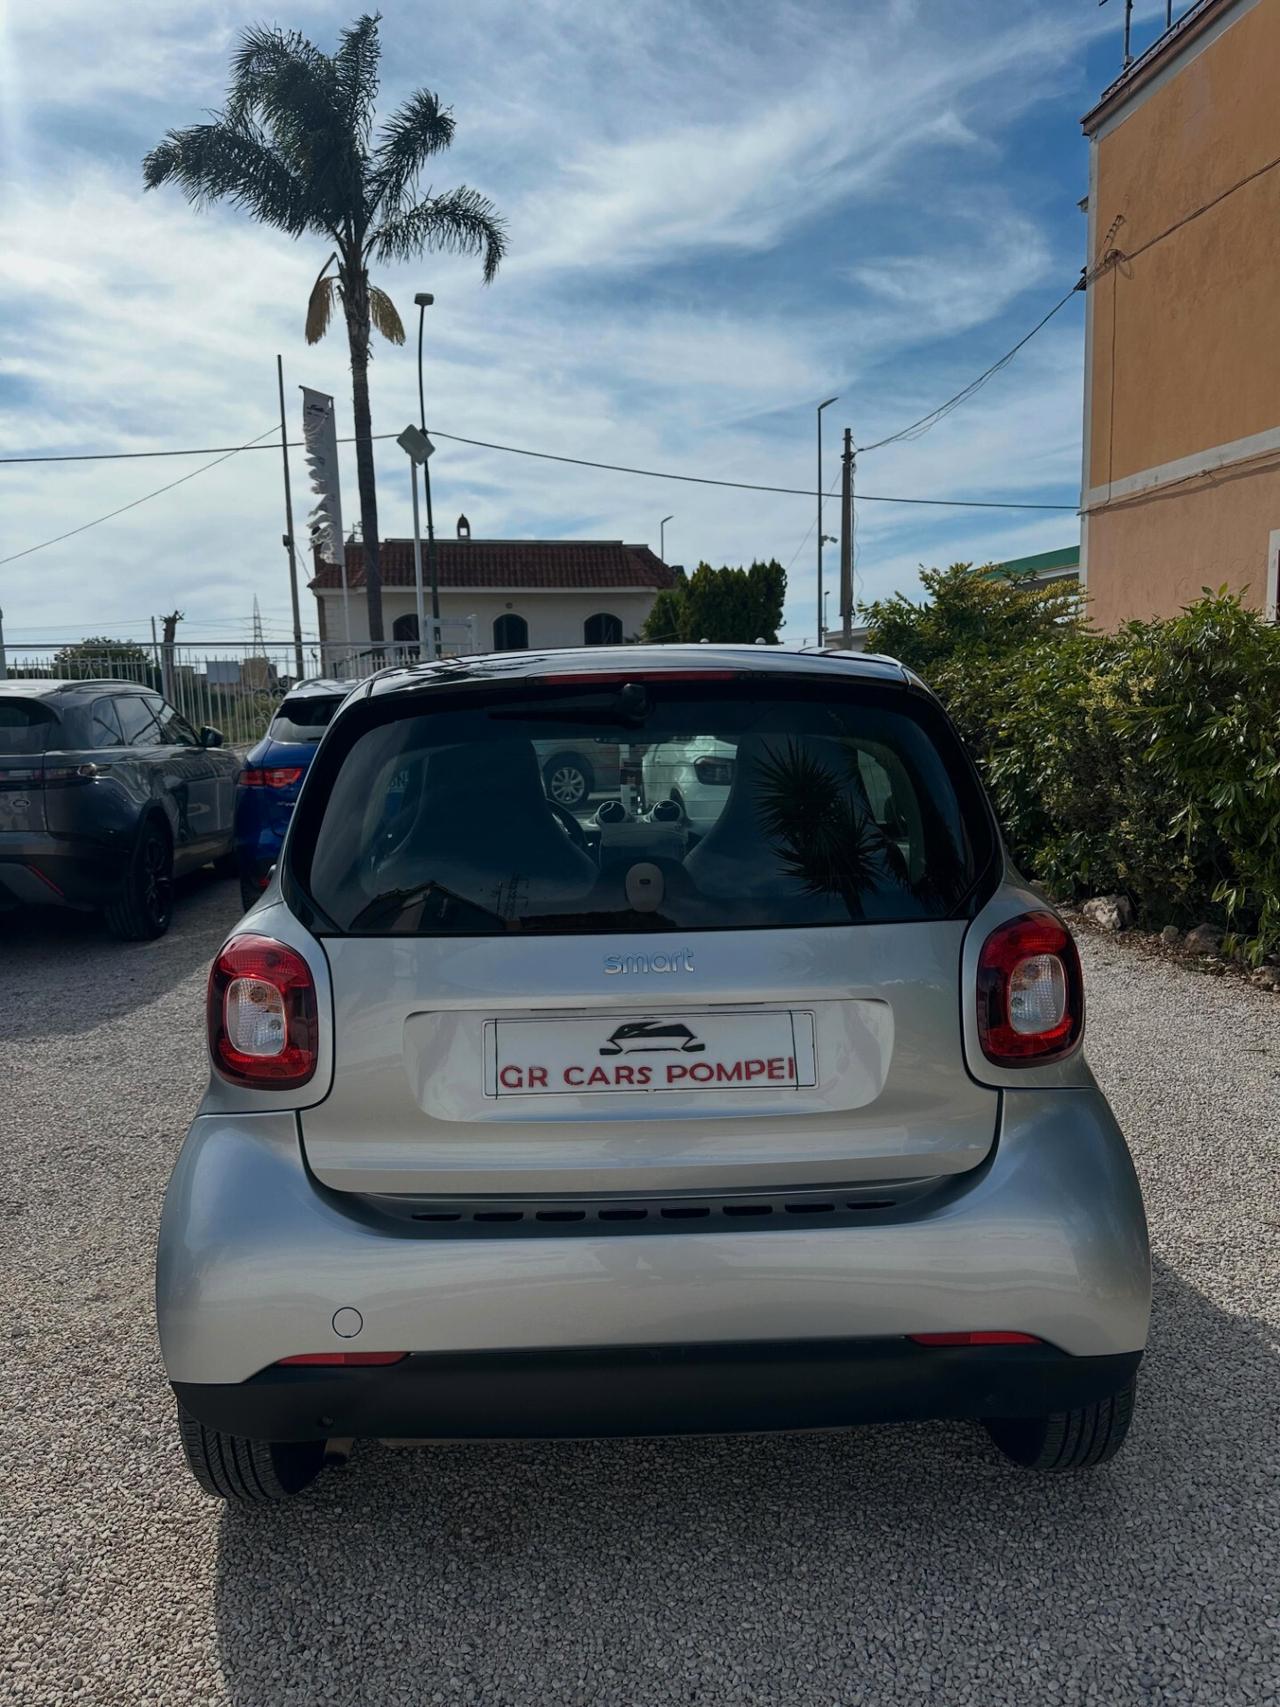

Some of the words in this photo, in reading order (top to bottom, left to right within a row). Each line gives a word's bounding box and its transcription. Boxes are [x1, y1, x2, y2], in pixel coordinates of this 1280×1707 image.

[604, 947, 694, 975] smart
[500, 1065, 548, 1088] GR
[563, 1065, 653, 1086] CARS
[666, 1056, 795, 1083] POMPEI
